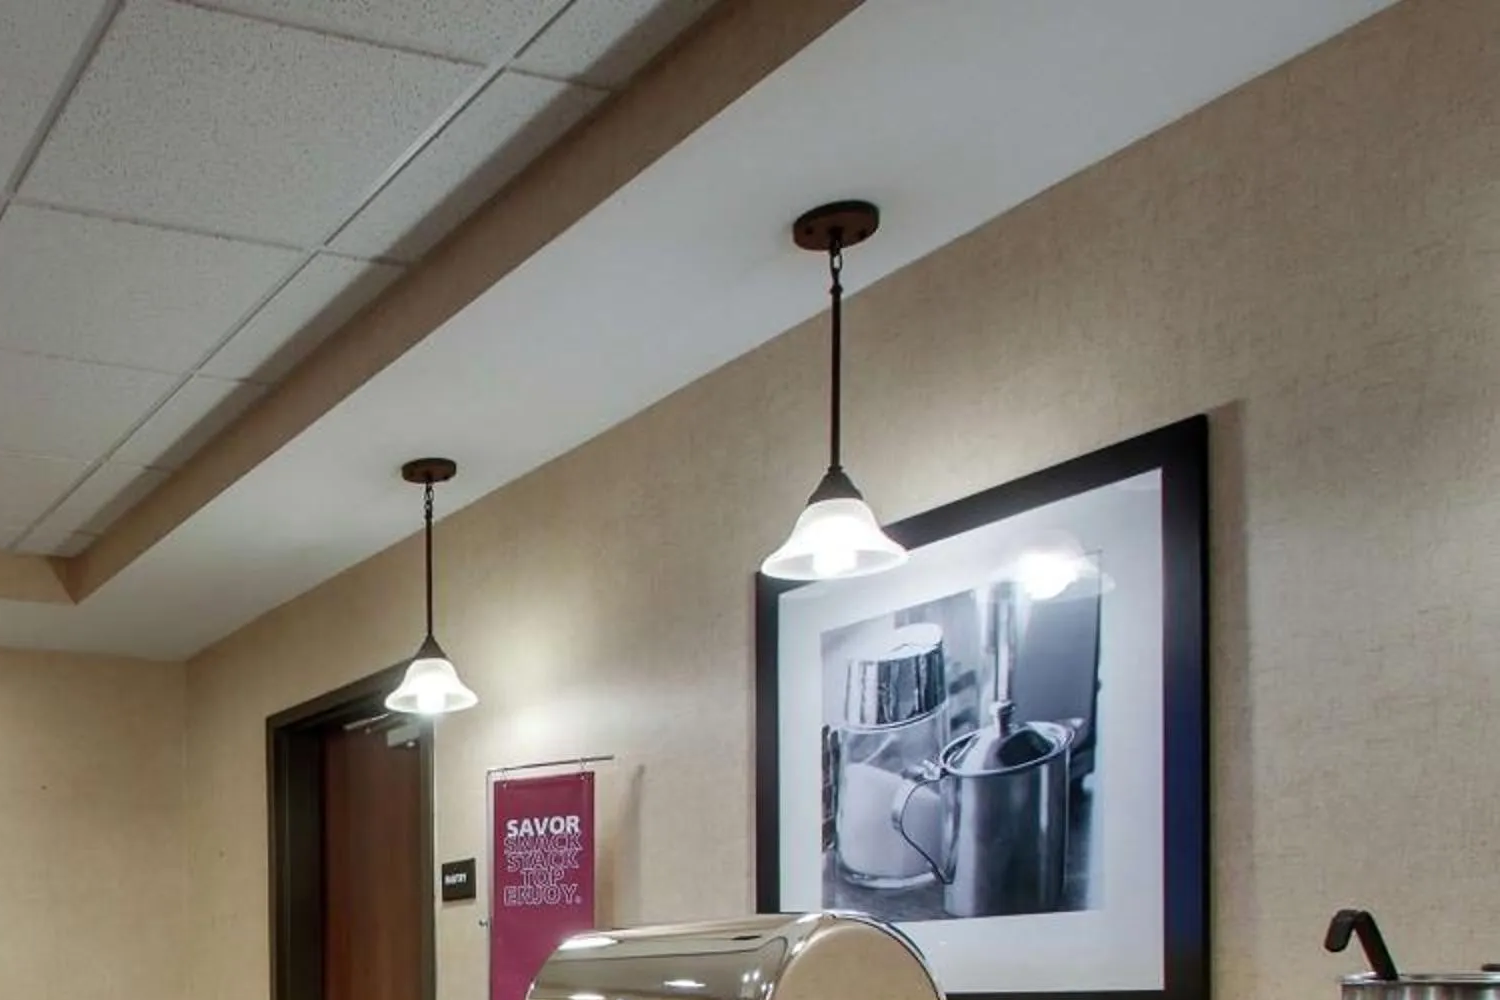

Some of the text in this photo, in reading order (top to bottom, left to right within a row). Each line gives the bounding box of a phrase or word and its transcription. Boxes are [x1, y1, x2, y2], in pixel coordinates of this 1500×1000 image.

[506, 815, 580, 837] SAVOR
[506, 848, 580, 873] STACK
[520, 864, 565, 888] TOP
[503, 883, 582, 906] ENJOY.
